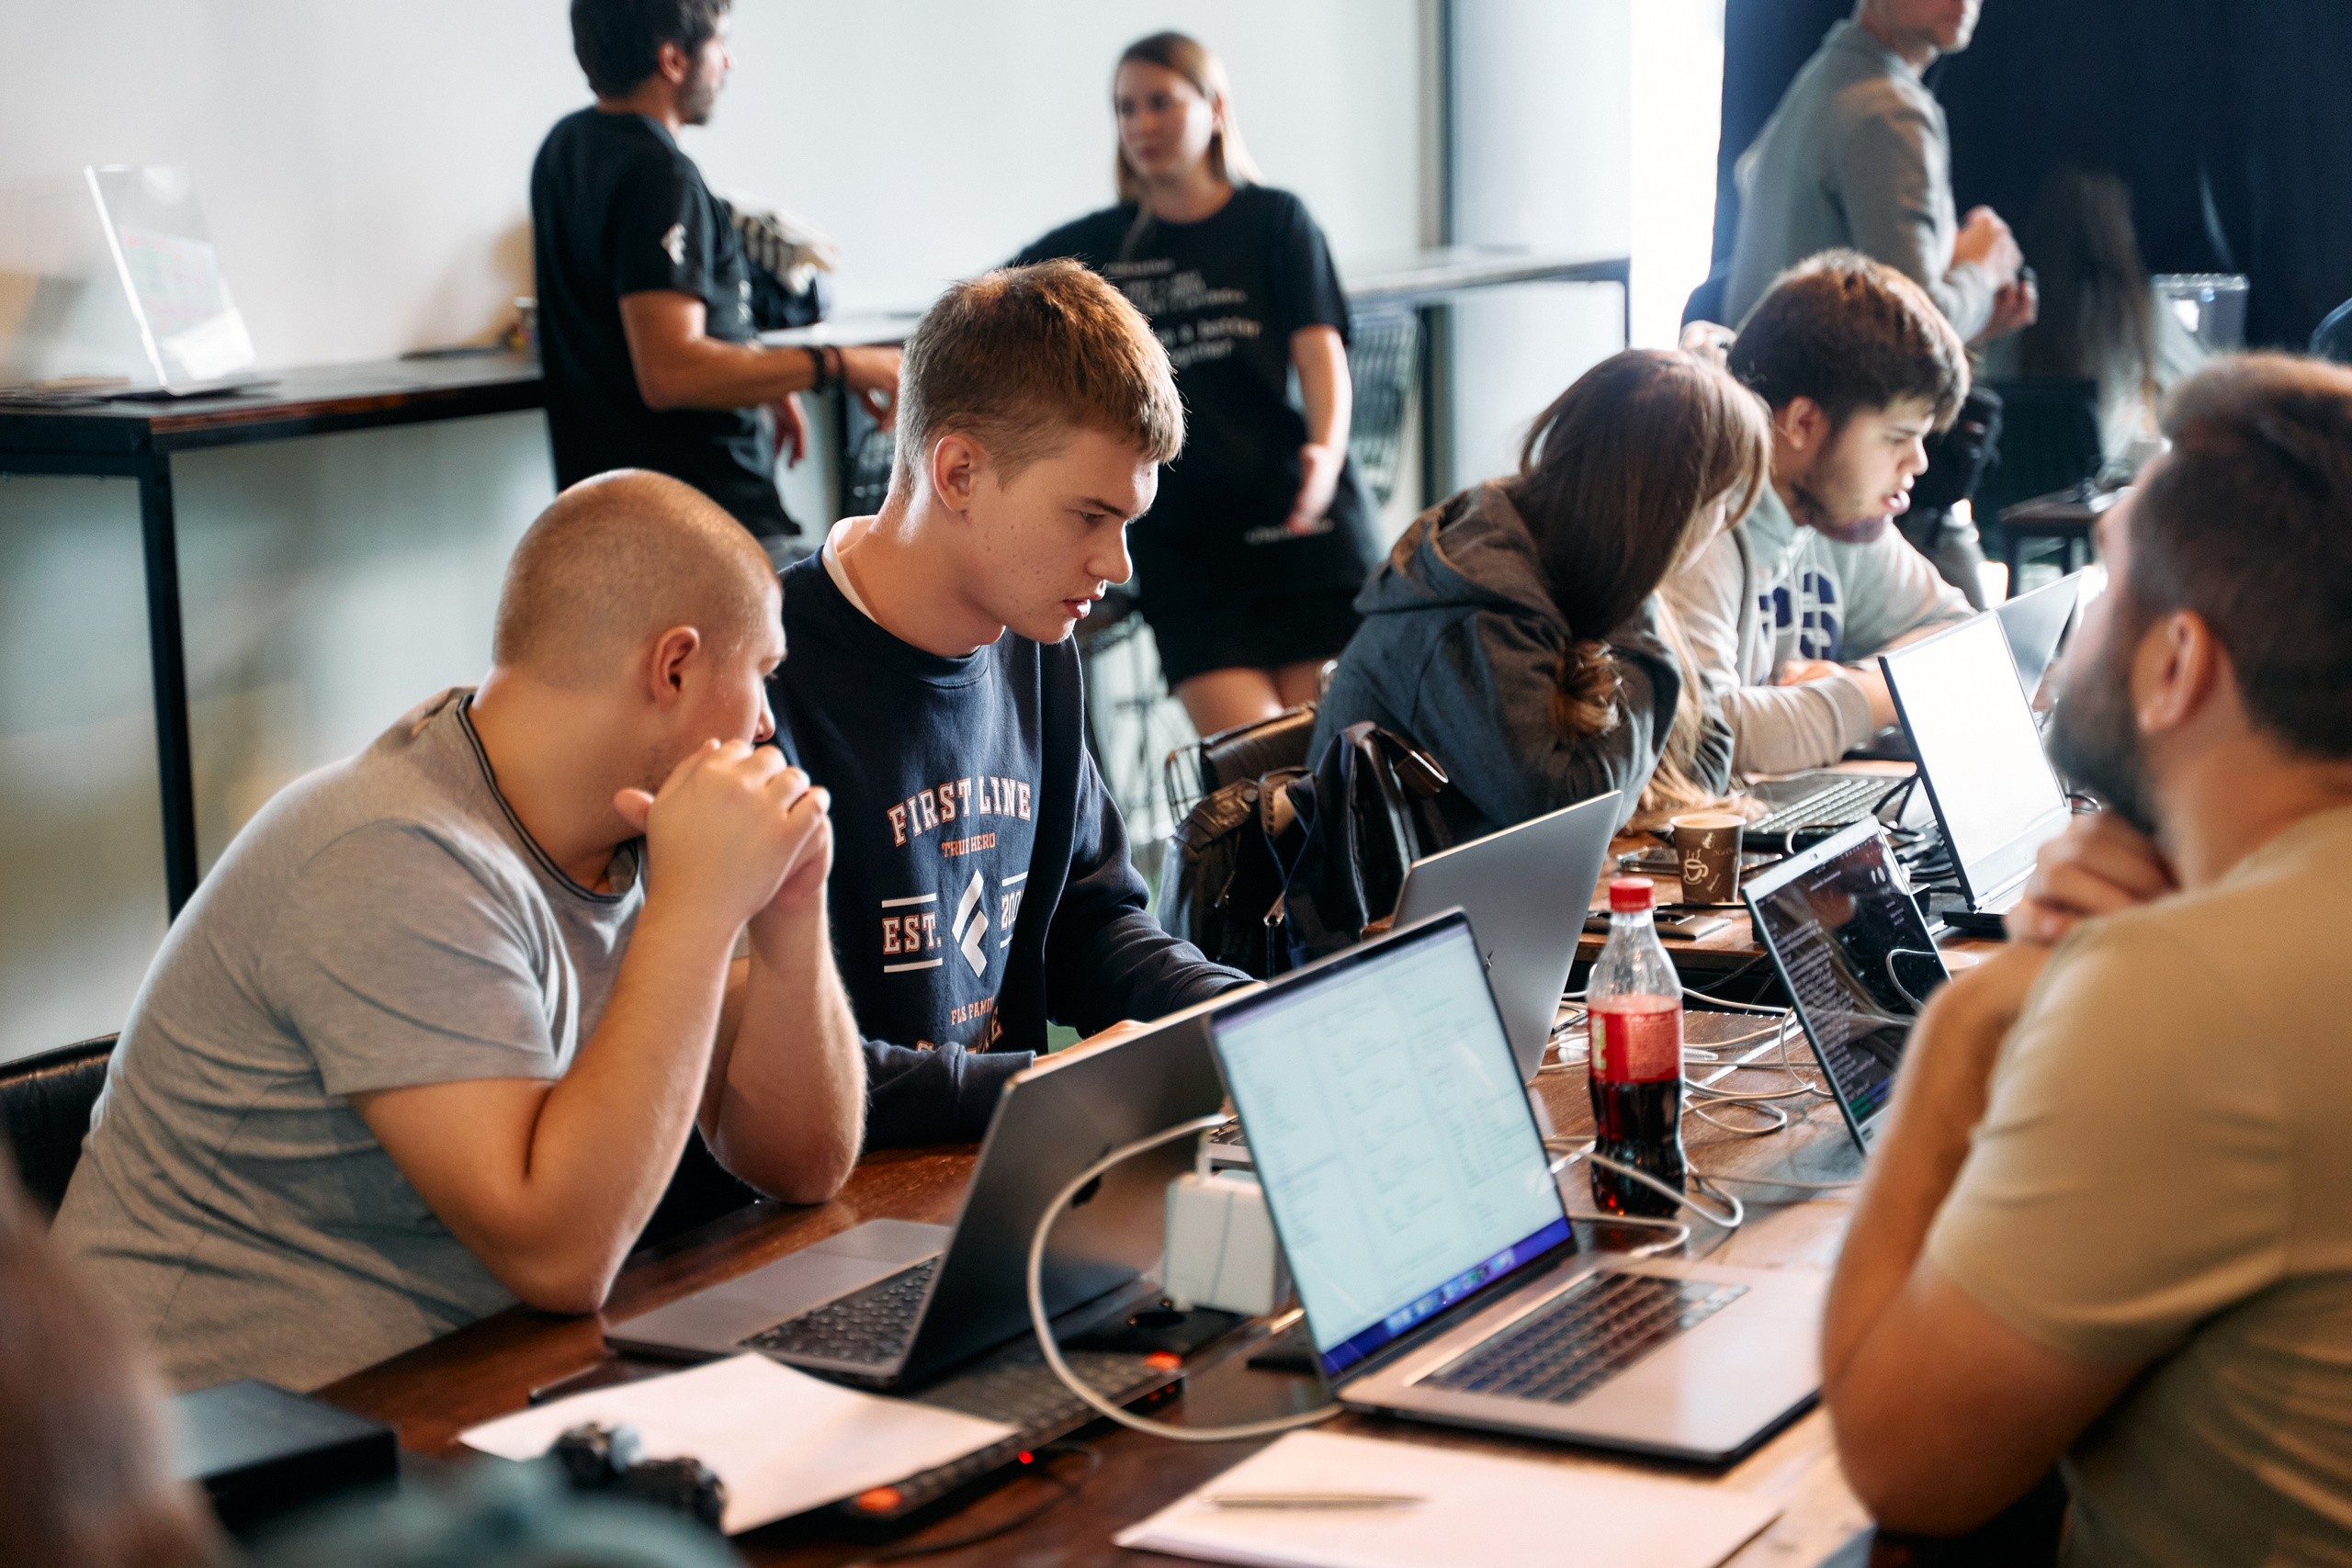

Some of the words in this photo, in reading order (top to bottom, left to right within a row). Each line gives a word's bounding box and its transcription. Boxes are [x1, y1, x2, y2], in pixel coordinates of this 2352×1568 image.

[888, 778, 972, 847] FIRST
[978, 776, 1032, 821] LINE
[942, 838, 969, 857] TRUE
[970, 832, 996, 852] HERO
[882, 911, 942, 954] EST.
[951, 1006, 967, 1026] FLS
